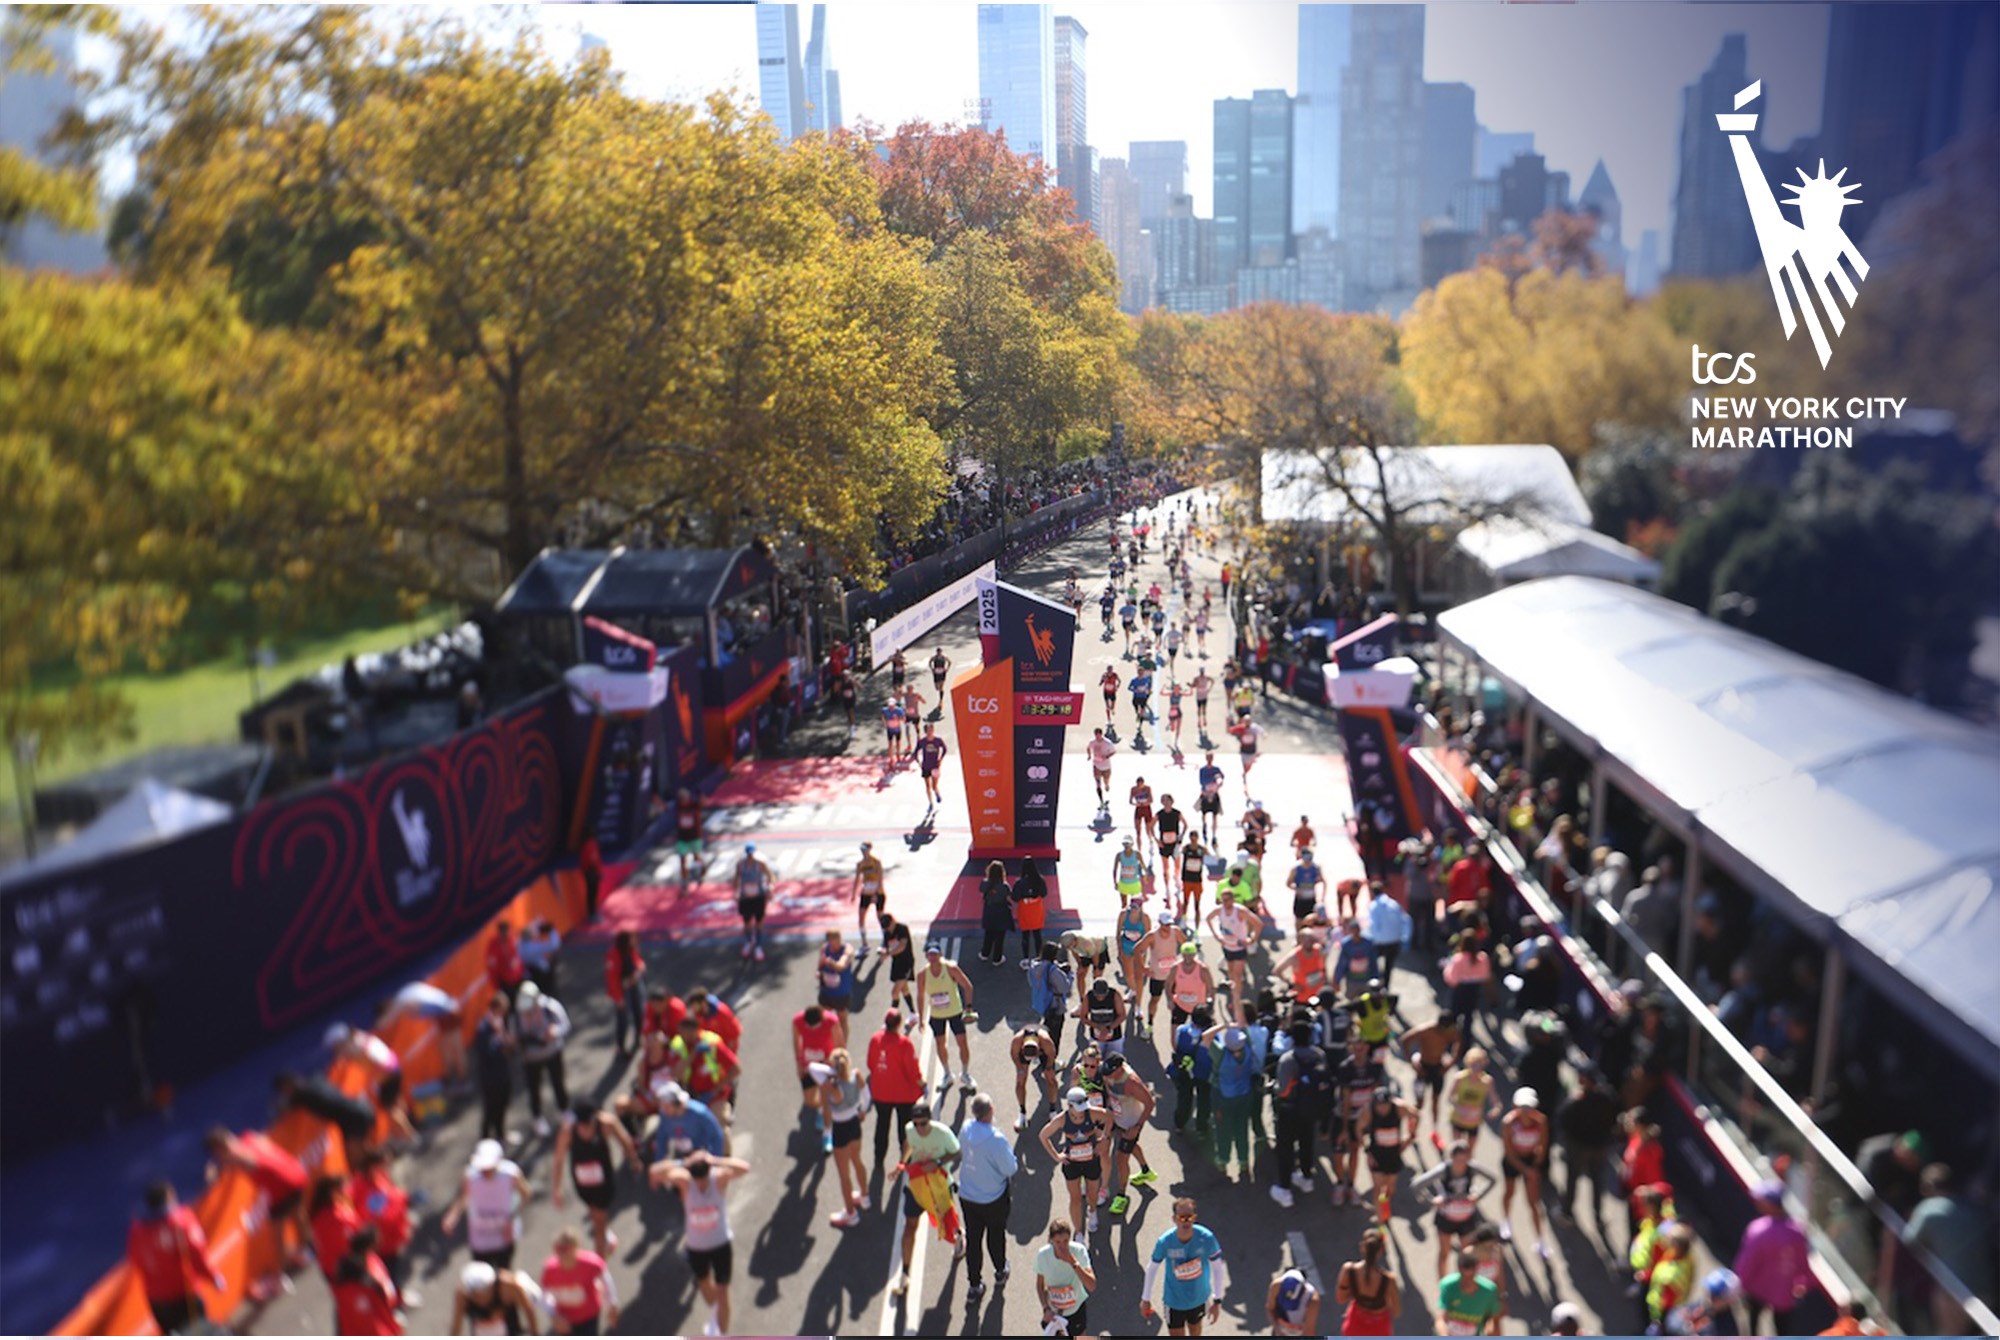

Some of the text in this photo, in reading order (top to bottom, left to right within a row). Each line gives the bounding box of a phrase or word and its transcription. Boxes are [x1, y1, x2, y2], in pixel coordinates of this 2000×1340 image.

[982, 589, 996, 629] 2025
[1353, 643, 1385, 662] tcs
[968, 694, 999, 714] tcs
[231, 706, 562, 1028] 2025
